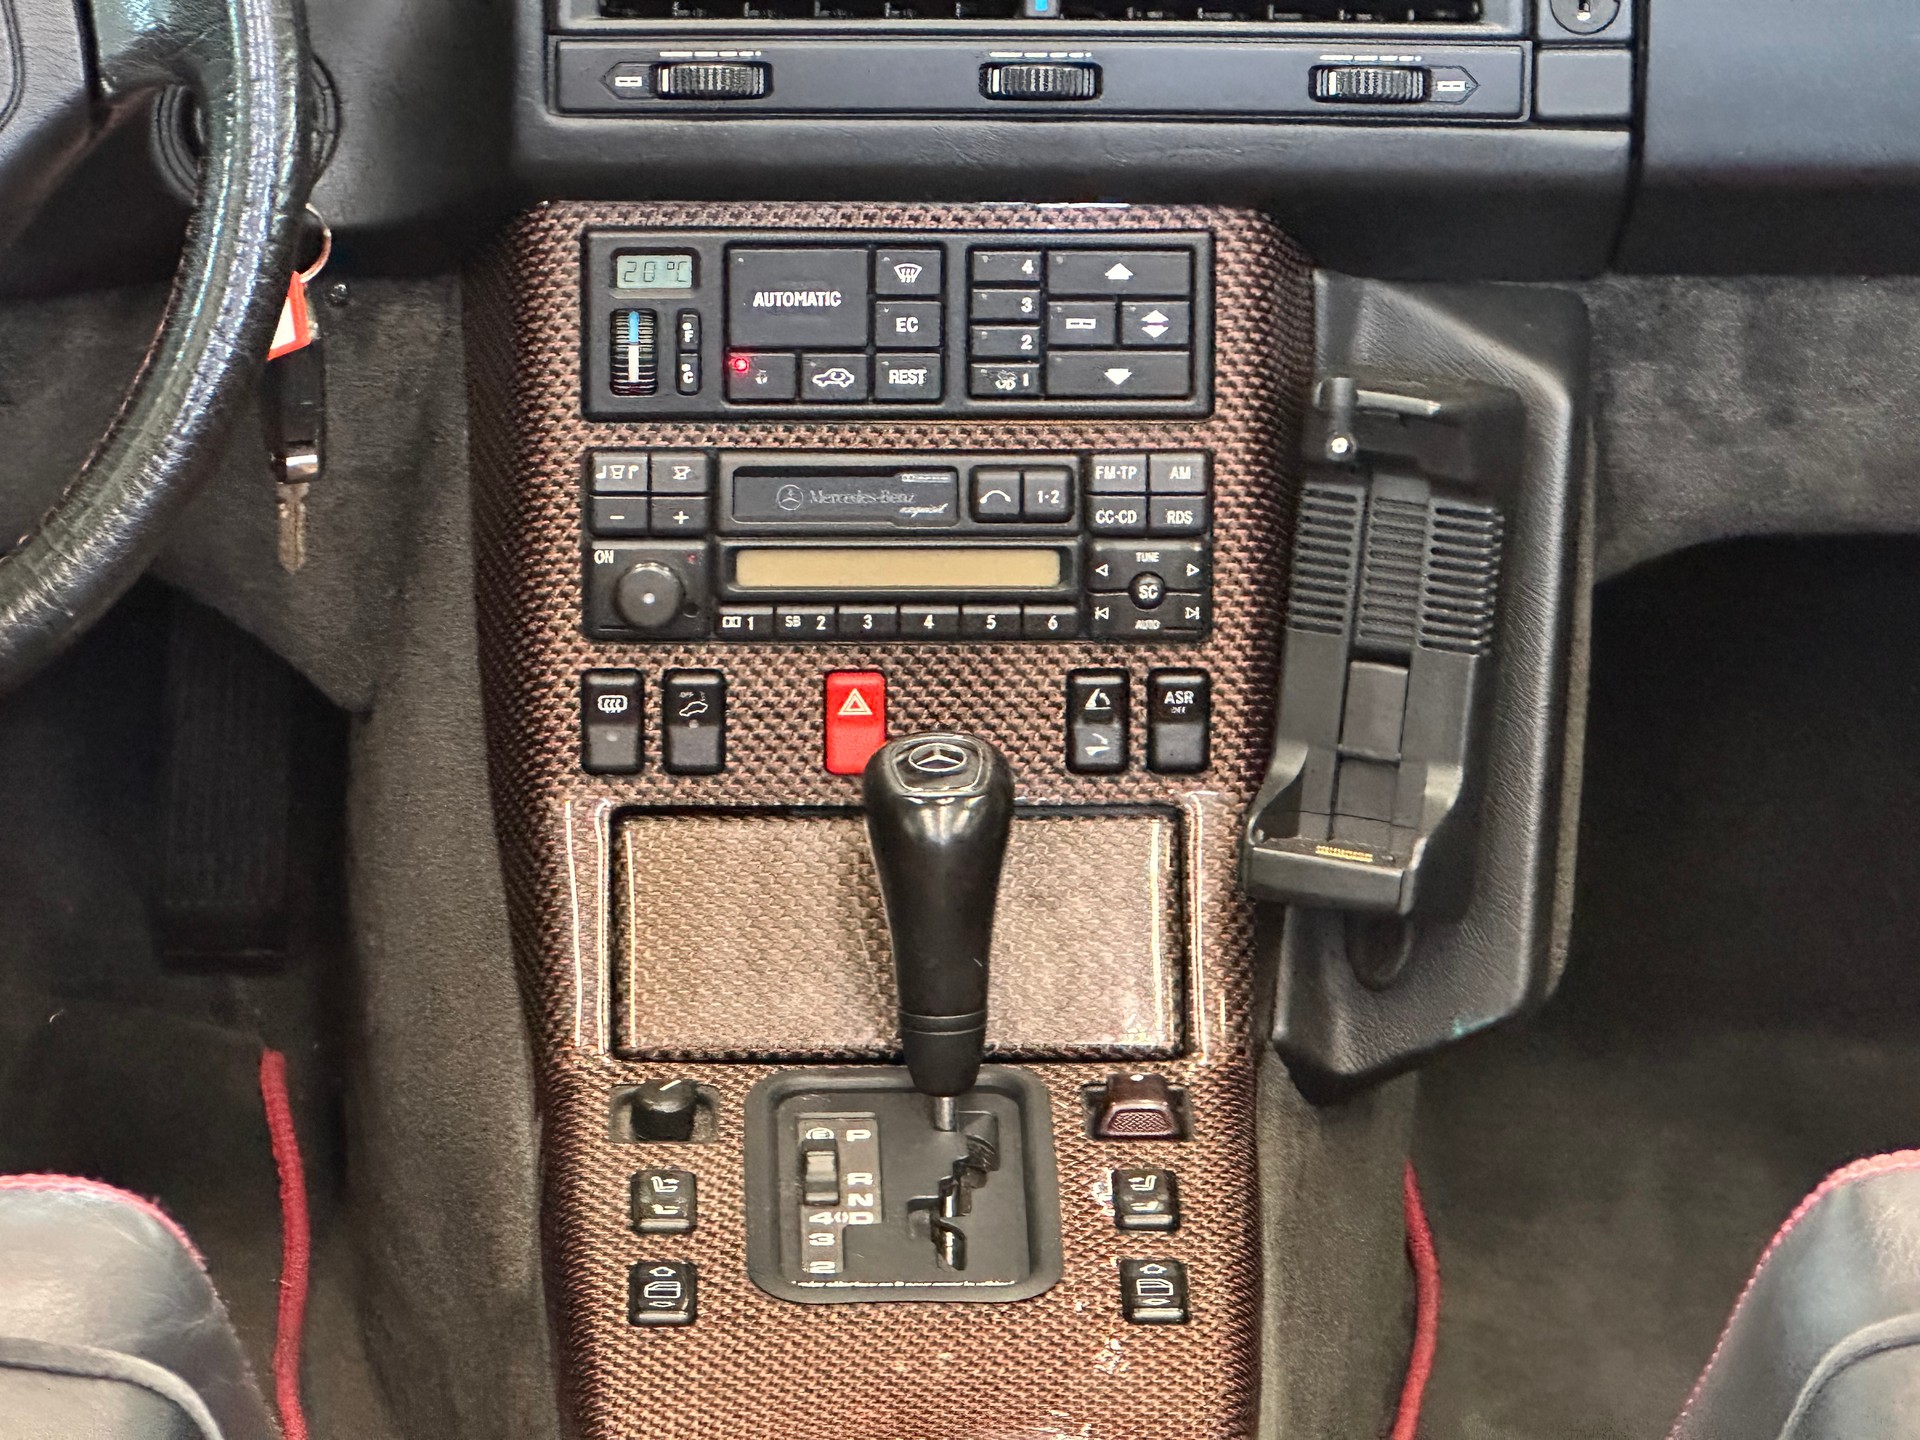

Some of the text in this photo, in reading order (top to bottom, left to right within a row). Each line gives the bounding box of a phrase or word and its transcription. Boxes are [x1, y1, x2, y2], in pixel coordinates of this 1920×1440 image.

[1021, 259, 1034, 275] 4
[752, 290, 842, 308] AUTOMATIC
[1020, 296, 1033, 313] 3
[895, 316, 919, 333] EC
[1020, 334, 1033, 351] 2
[888, 368, 928, 386] REST
[1022, 372, 1030, 387] 1
[1169, 465, 1192, 480] AM
[1165, 509, 1194, 525] RDS
[593, 549, 615, 565] ON
[1135, 551, 1160, 563] TUNE
[1138, 584, 1159, 600] SC
[746, 616, 754, 631] 1
[816, 615, 827, 631] 2
[862, 613, 873, 630] 3
[923, 614, 936, 630] 4
[985, 614, 998, 630] 5
[1047, 615, 1059, 631] 6
[1163, 690, 1195, 705] ASR
[845, 1129, 872, 1142] P
[846, 1172, 874, 1186] R
[847, 1192, 874, 1207] N
[808, 1211, 874, 1225] 4 D
[808, 1232, 836, 1246] 3
[809, 1260, 836, 1274] 2
